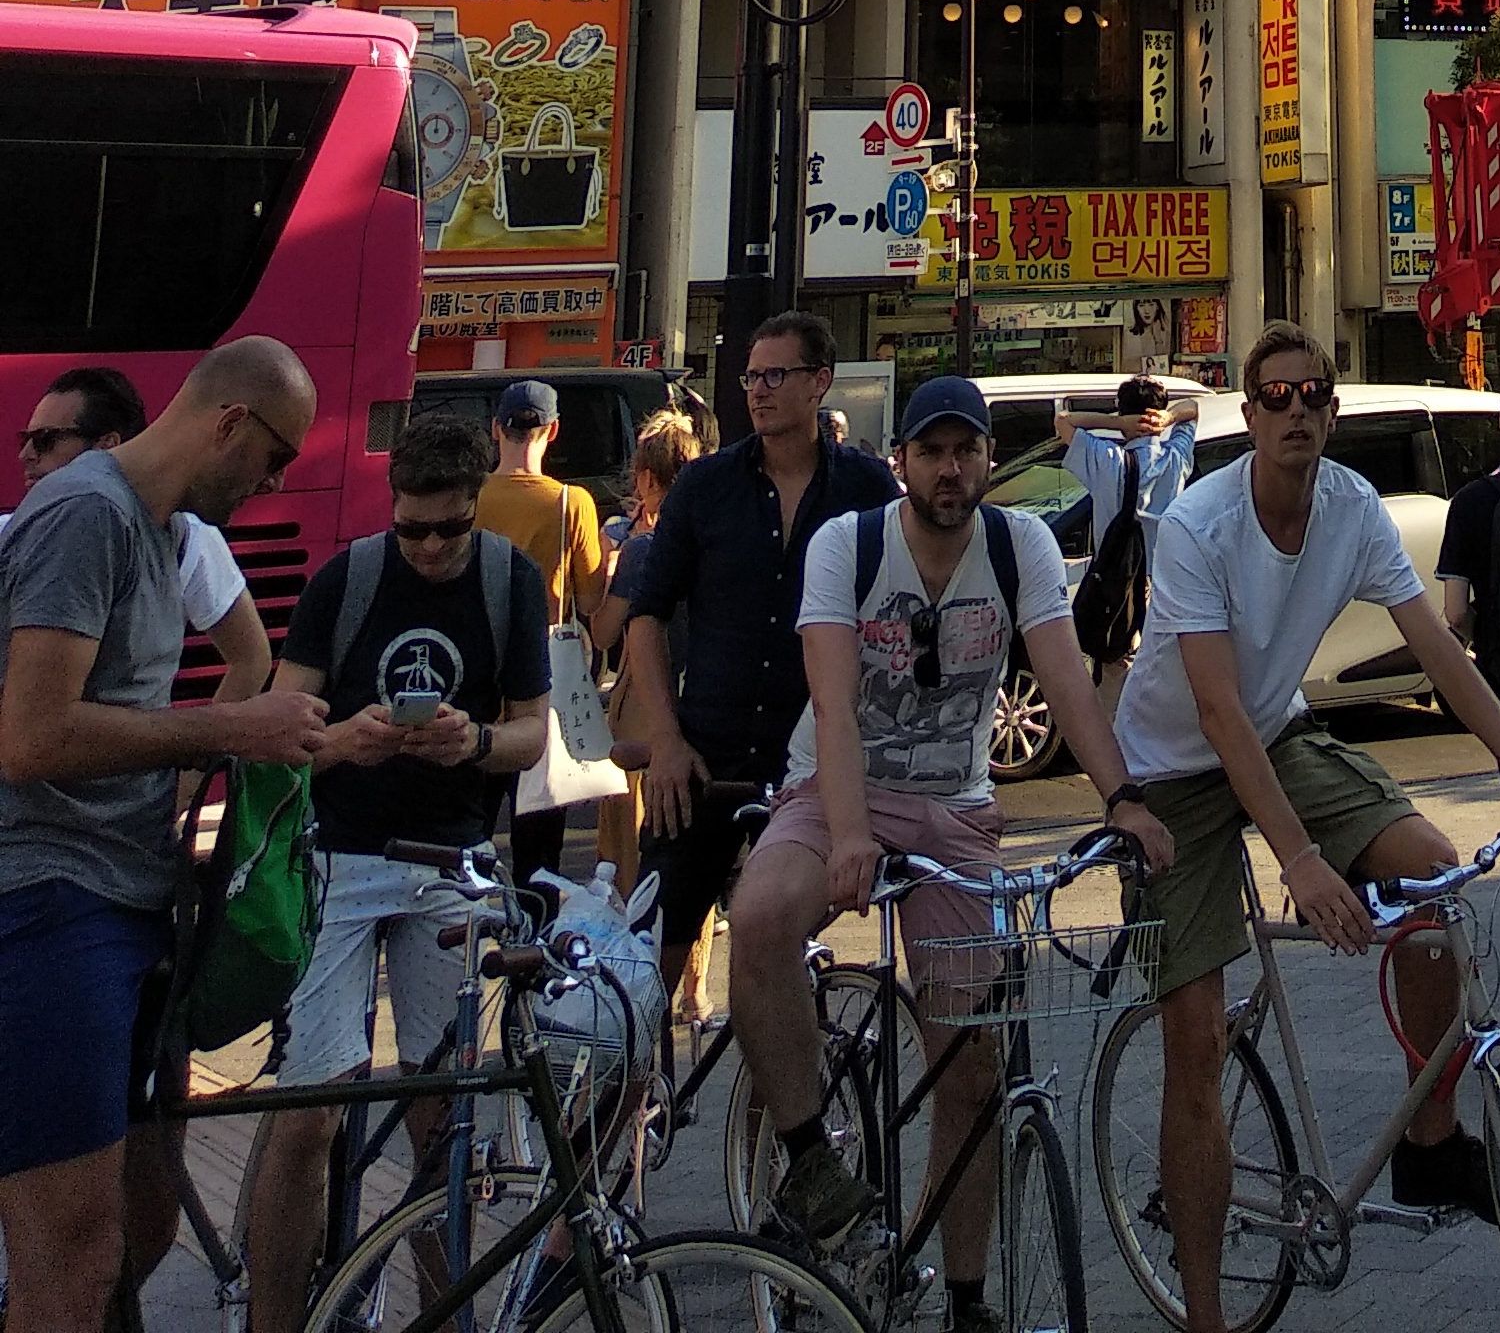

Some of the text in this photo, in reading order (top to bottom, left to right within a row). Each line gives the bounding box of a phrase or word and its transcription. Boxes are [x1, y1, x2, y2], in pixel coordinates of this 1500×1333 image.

[1148, 52, 1169, 137] ルノアール
[1199, 17, 1215, 156] ルノアール
[896, 101, 919, 131] 40
[866, 141, 884, 154] 2F
[895, 188, 911, 230] P
[1392, 189, 1411, 206] 8F
[1087, 191, 1211, 239] TAX FREE
[1392, 212, 1412, 228] 7F
[936, 264, 1011, 282] 東電気
[621, 343, 654, 369] 4F
